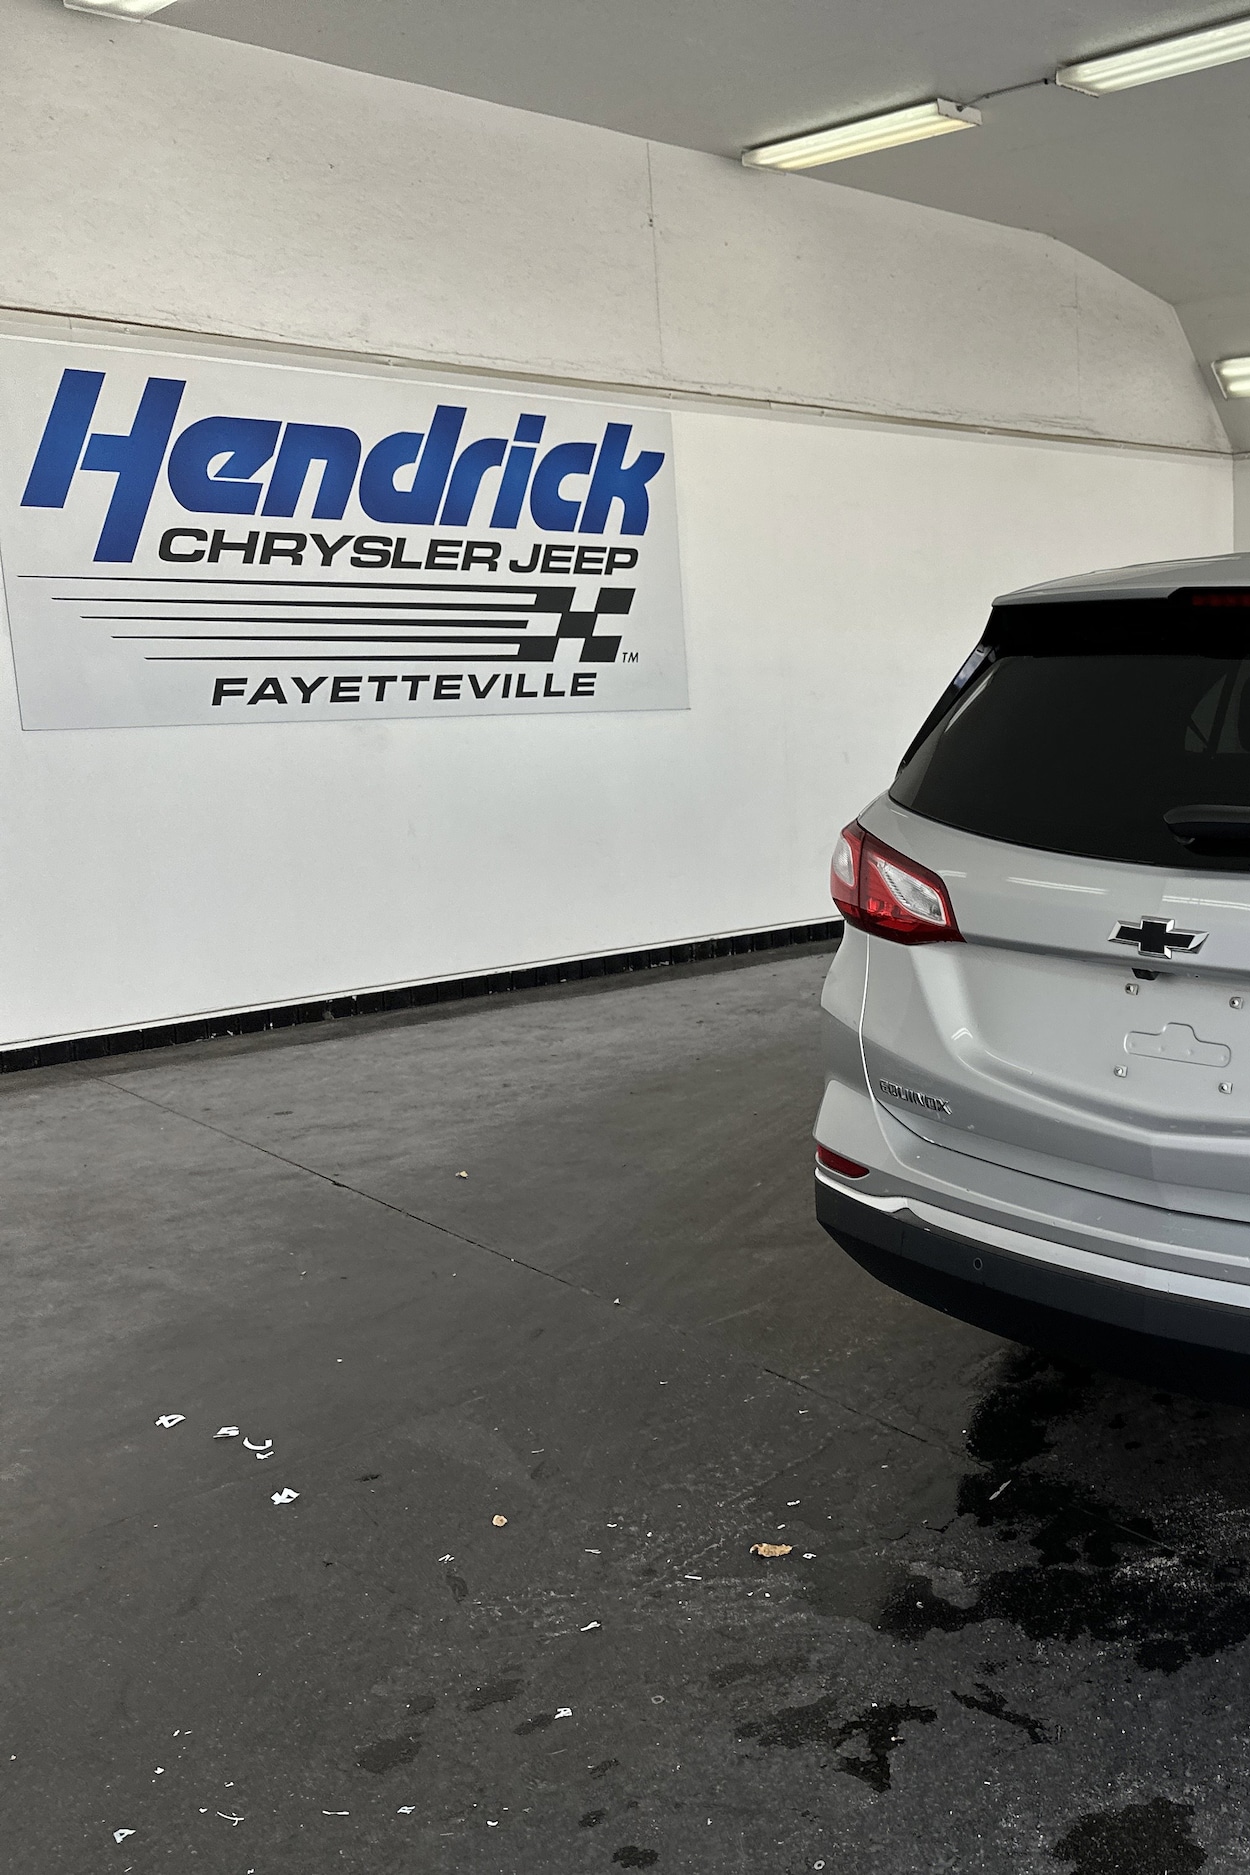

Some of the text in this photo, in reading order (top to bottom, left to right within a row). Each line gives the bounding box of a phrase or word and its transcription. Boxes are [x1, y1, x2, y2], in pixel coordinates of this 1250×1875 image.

[20, 368, 666, 563] Hendrick
[158, 527, 640, 575] CHRYSLER JEEP
[622, 651, 639, 664] TM
[211, 672, 597, 706] FAYETTEVILLE
[879, 1078, 953, 1115] EQUINOX
